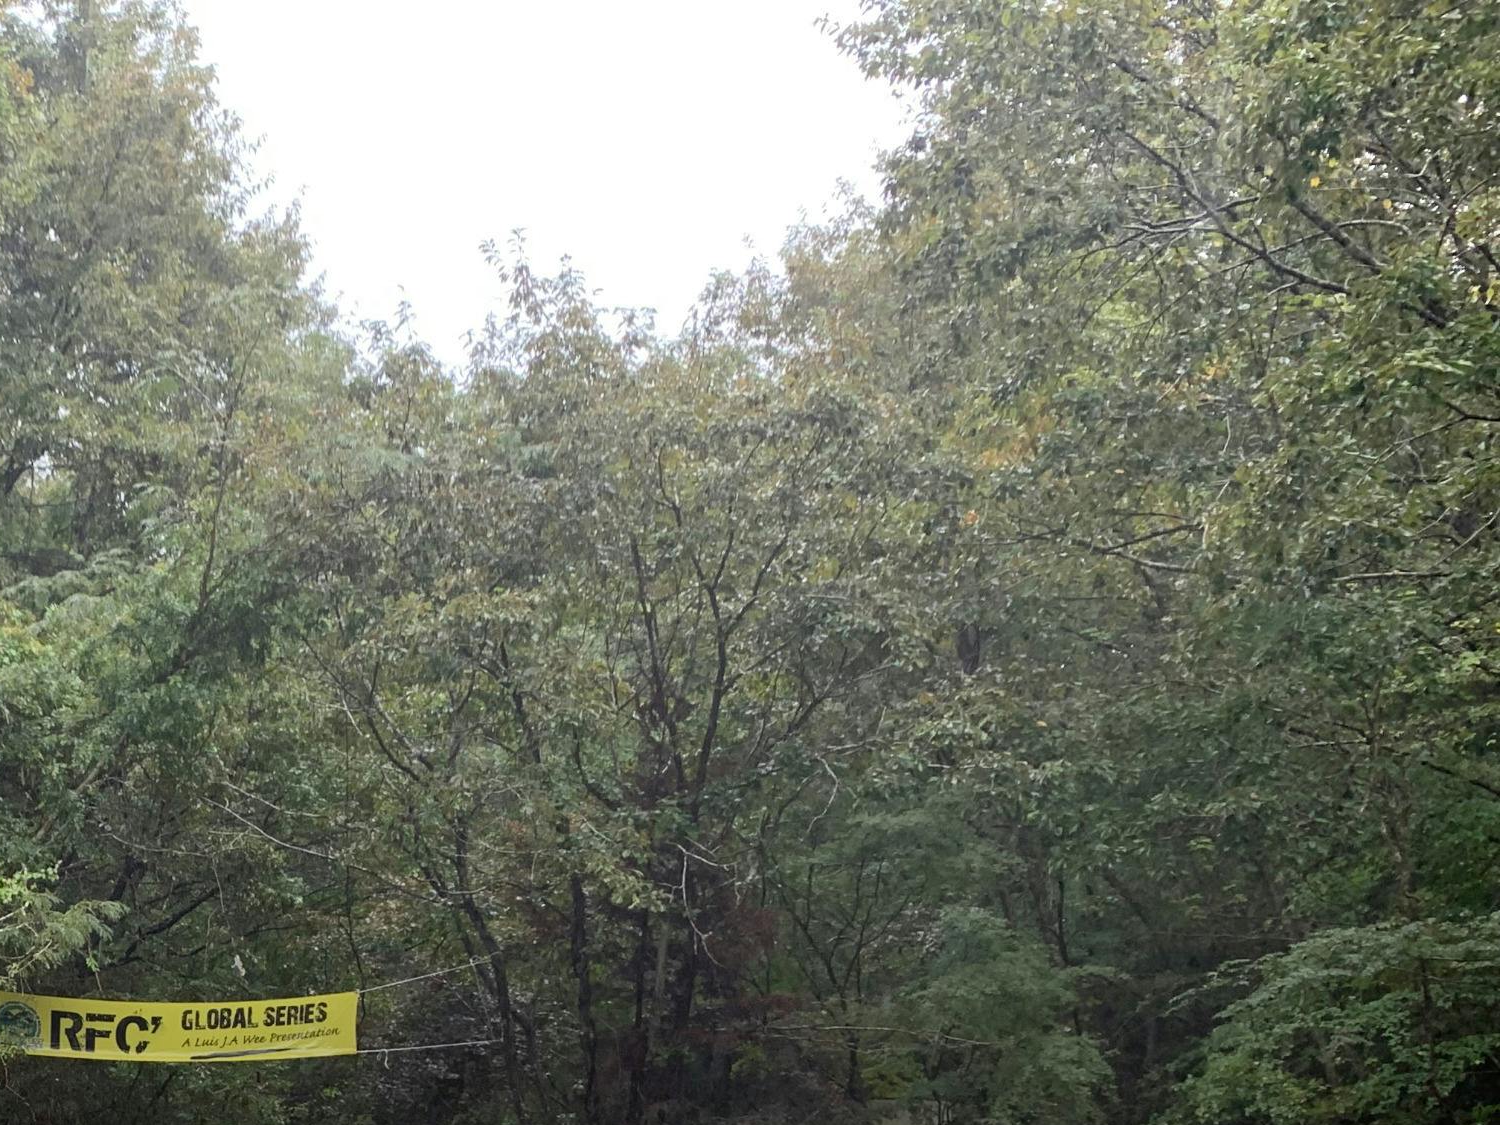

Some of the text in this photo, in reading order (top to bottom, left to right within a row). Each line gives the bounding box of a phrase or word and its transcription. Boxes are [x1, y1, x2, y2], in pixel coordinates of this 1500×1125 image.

[181, 1002, 328, 1031] GLOBAL SERIES
[182, 1038, 191, 1047] A
[195, 1036, 218, 1047] Luis
[244, 1034, 266, 1044] Wee
[270, 1028, 340, 1042] Presentation
